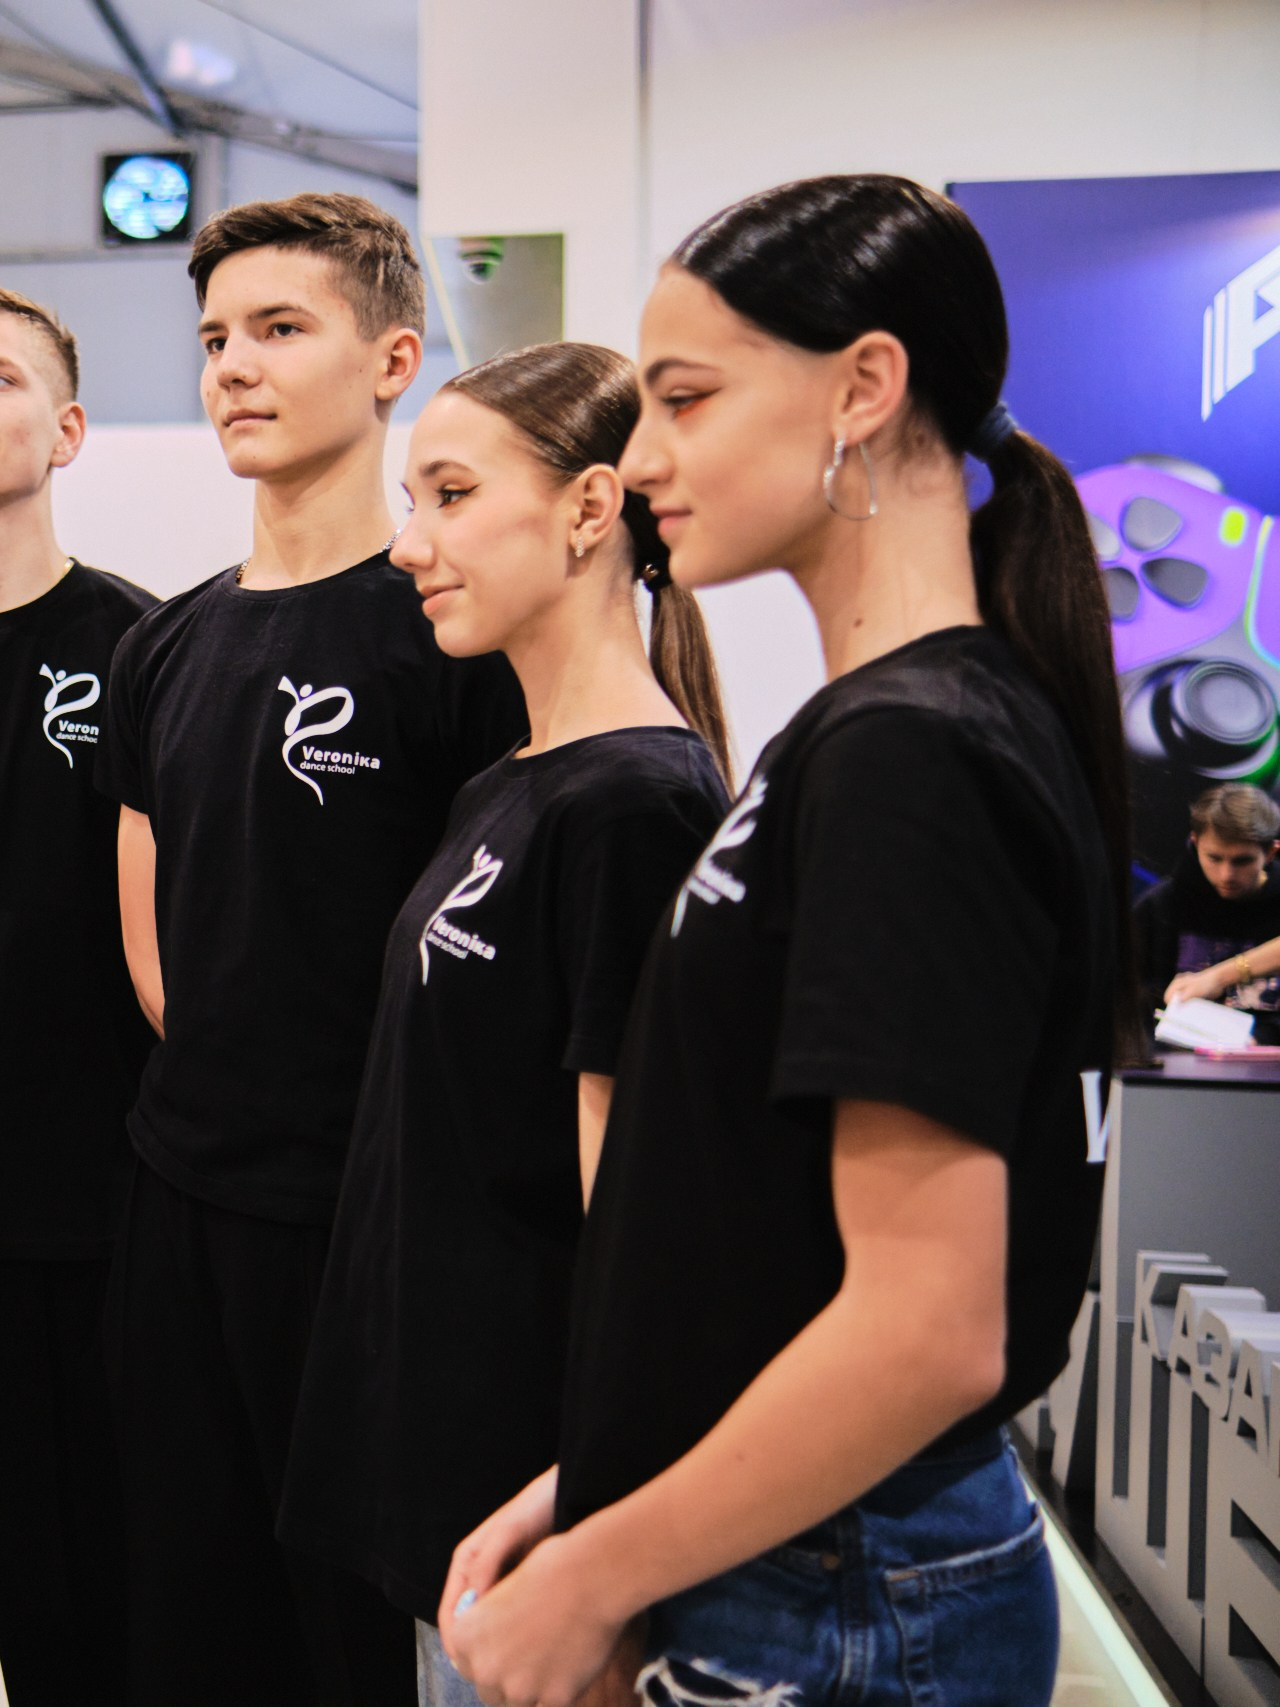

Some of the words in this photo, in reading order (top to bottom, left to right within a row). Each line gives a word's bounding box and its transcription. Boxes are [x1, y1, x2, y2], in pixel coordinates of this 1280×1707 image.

[58, 719, 99, 735] Veron
[56, 732, 77, 740] dance
[302, 745, 381, 770] Veronika
[299, 760, 326, 771] dance
[327, 763, 356, 775] school
[1133, 1250, 1280, 1476] КАЗА
